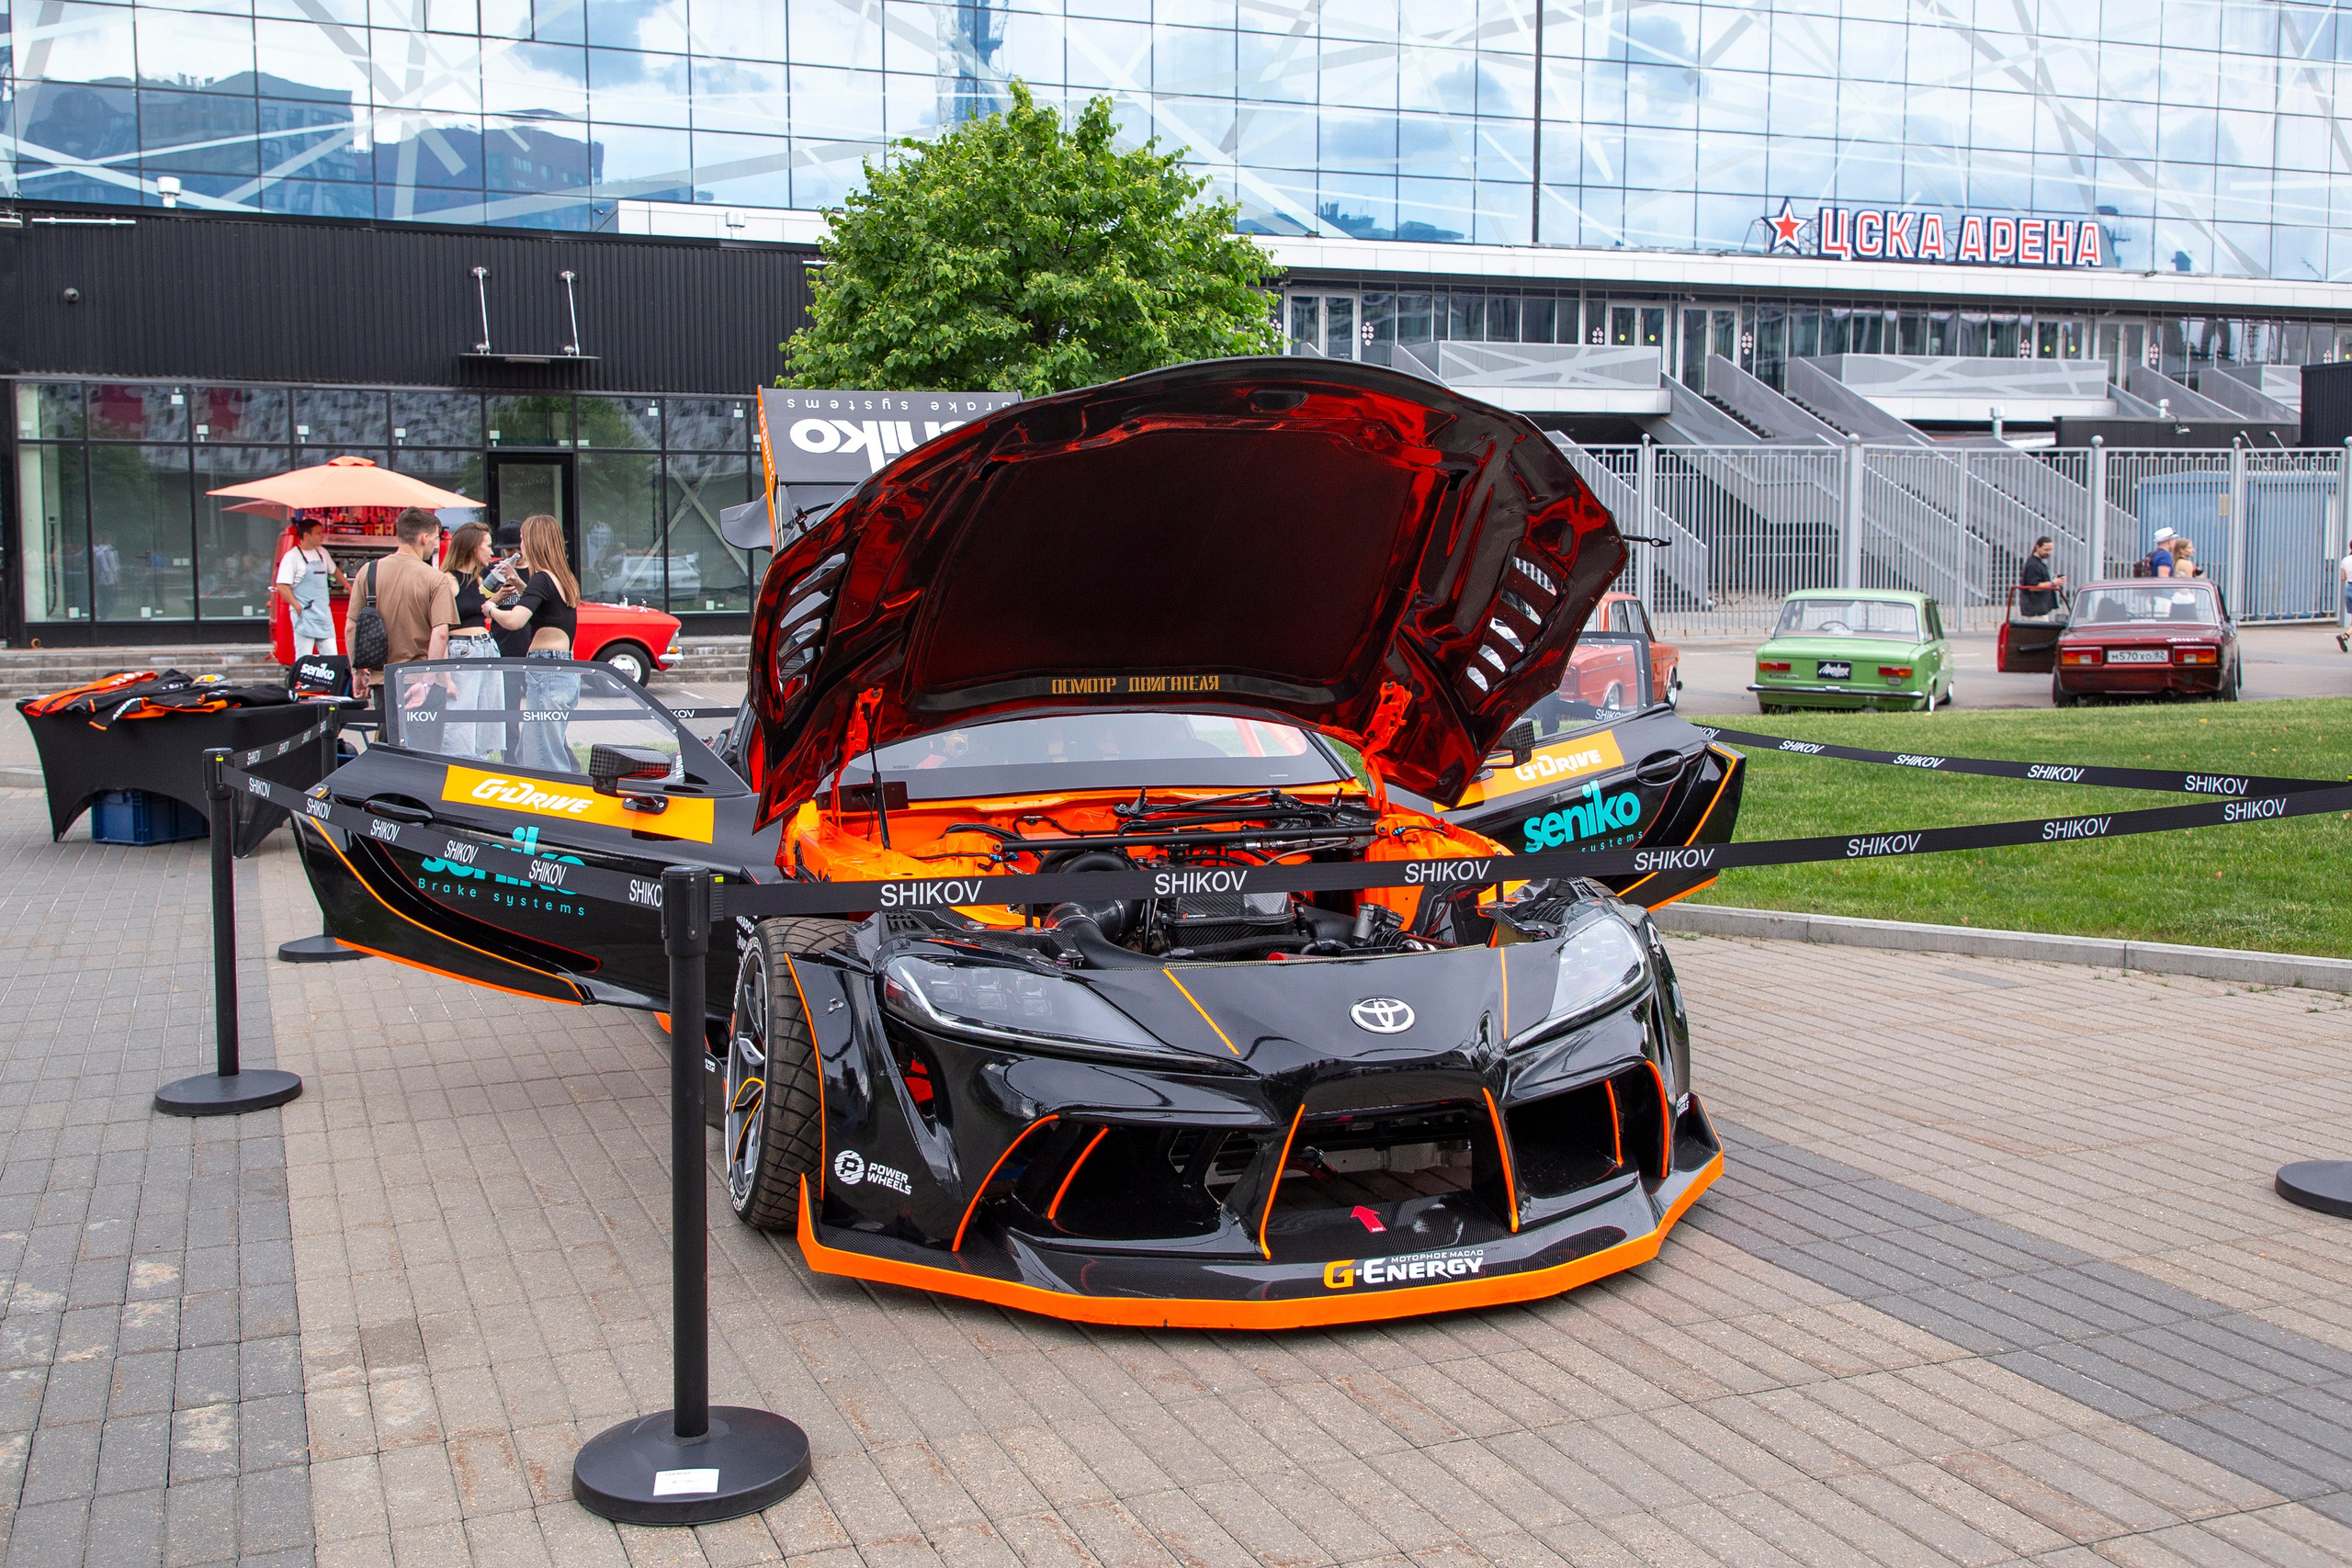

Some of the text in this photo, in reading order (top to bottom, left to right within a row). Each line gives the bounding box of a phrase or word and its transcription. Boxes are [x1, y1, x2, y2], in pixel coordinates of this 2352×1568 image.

[1818, 207, 2102, 266] ЦСКА АРЕНА
[786, 398, 909, 411] systems
[300, 663, 335, 681] seniko
[1052, 675, 1219, 694] ОСМОТР ДВИГАТЕЛЯ
[523, 711, 570, 721] SHIKOV
[1779, 739, 2248, 795] SHIKOV SHIKOV SHIKOV SHIKOV
[471, 778, 594, 814] G-DRIVE
[1523, 780, 1641, 853] seniko
[249, 777, 662, 908] SHIKOV SHIKOV SHIKOV SHIKOV SHIKOV SHIKO
[881, 797, 2287, 907] SHIKOV SHIKOV SHIKOV SHIKOV SHIKOV SHIKOV SHIKOV
[418, 877, 585, 916] Brake systems
[867, 1172, 912, 1195] WHEELS
[868, 1162, 909, 1184] POWER
[1391, 1249, 1484, 1263] МОТОРНОЕ МАСЛО
[1323, 1257, 1484, 1289] G-ENERGY
